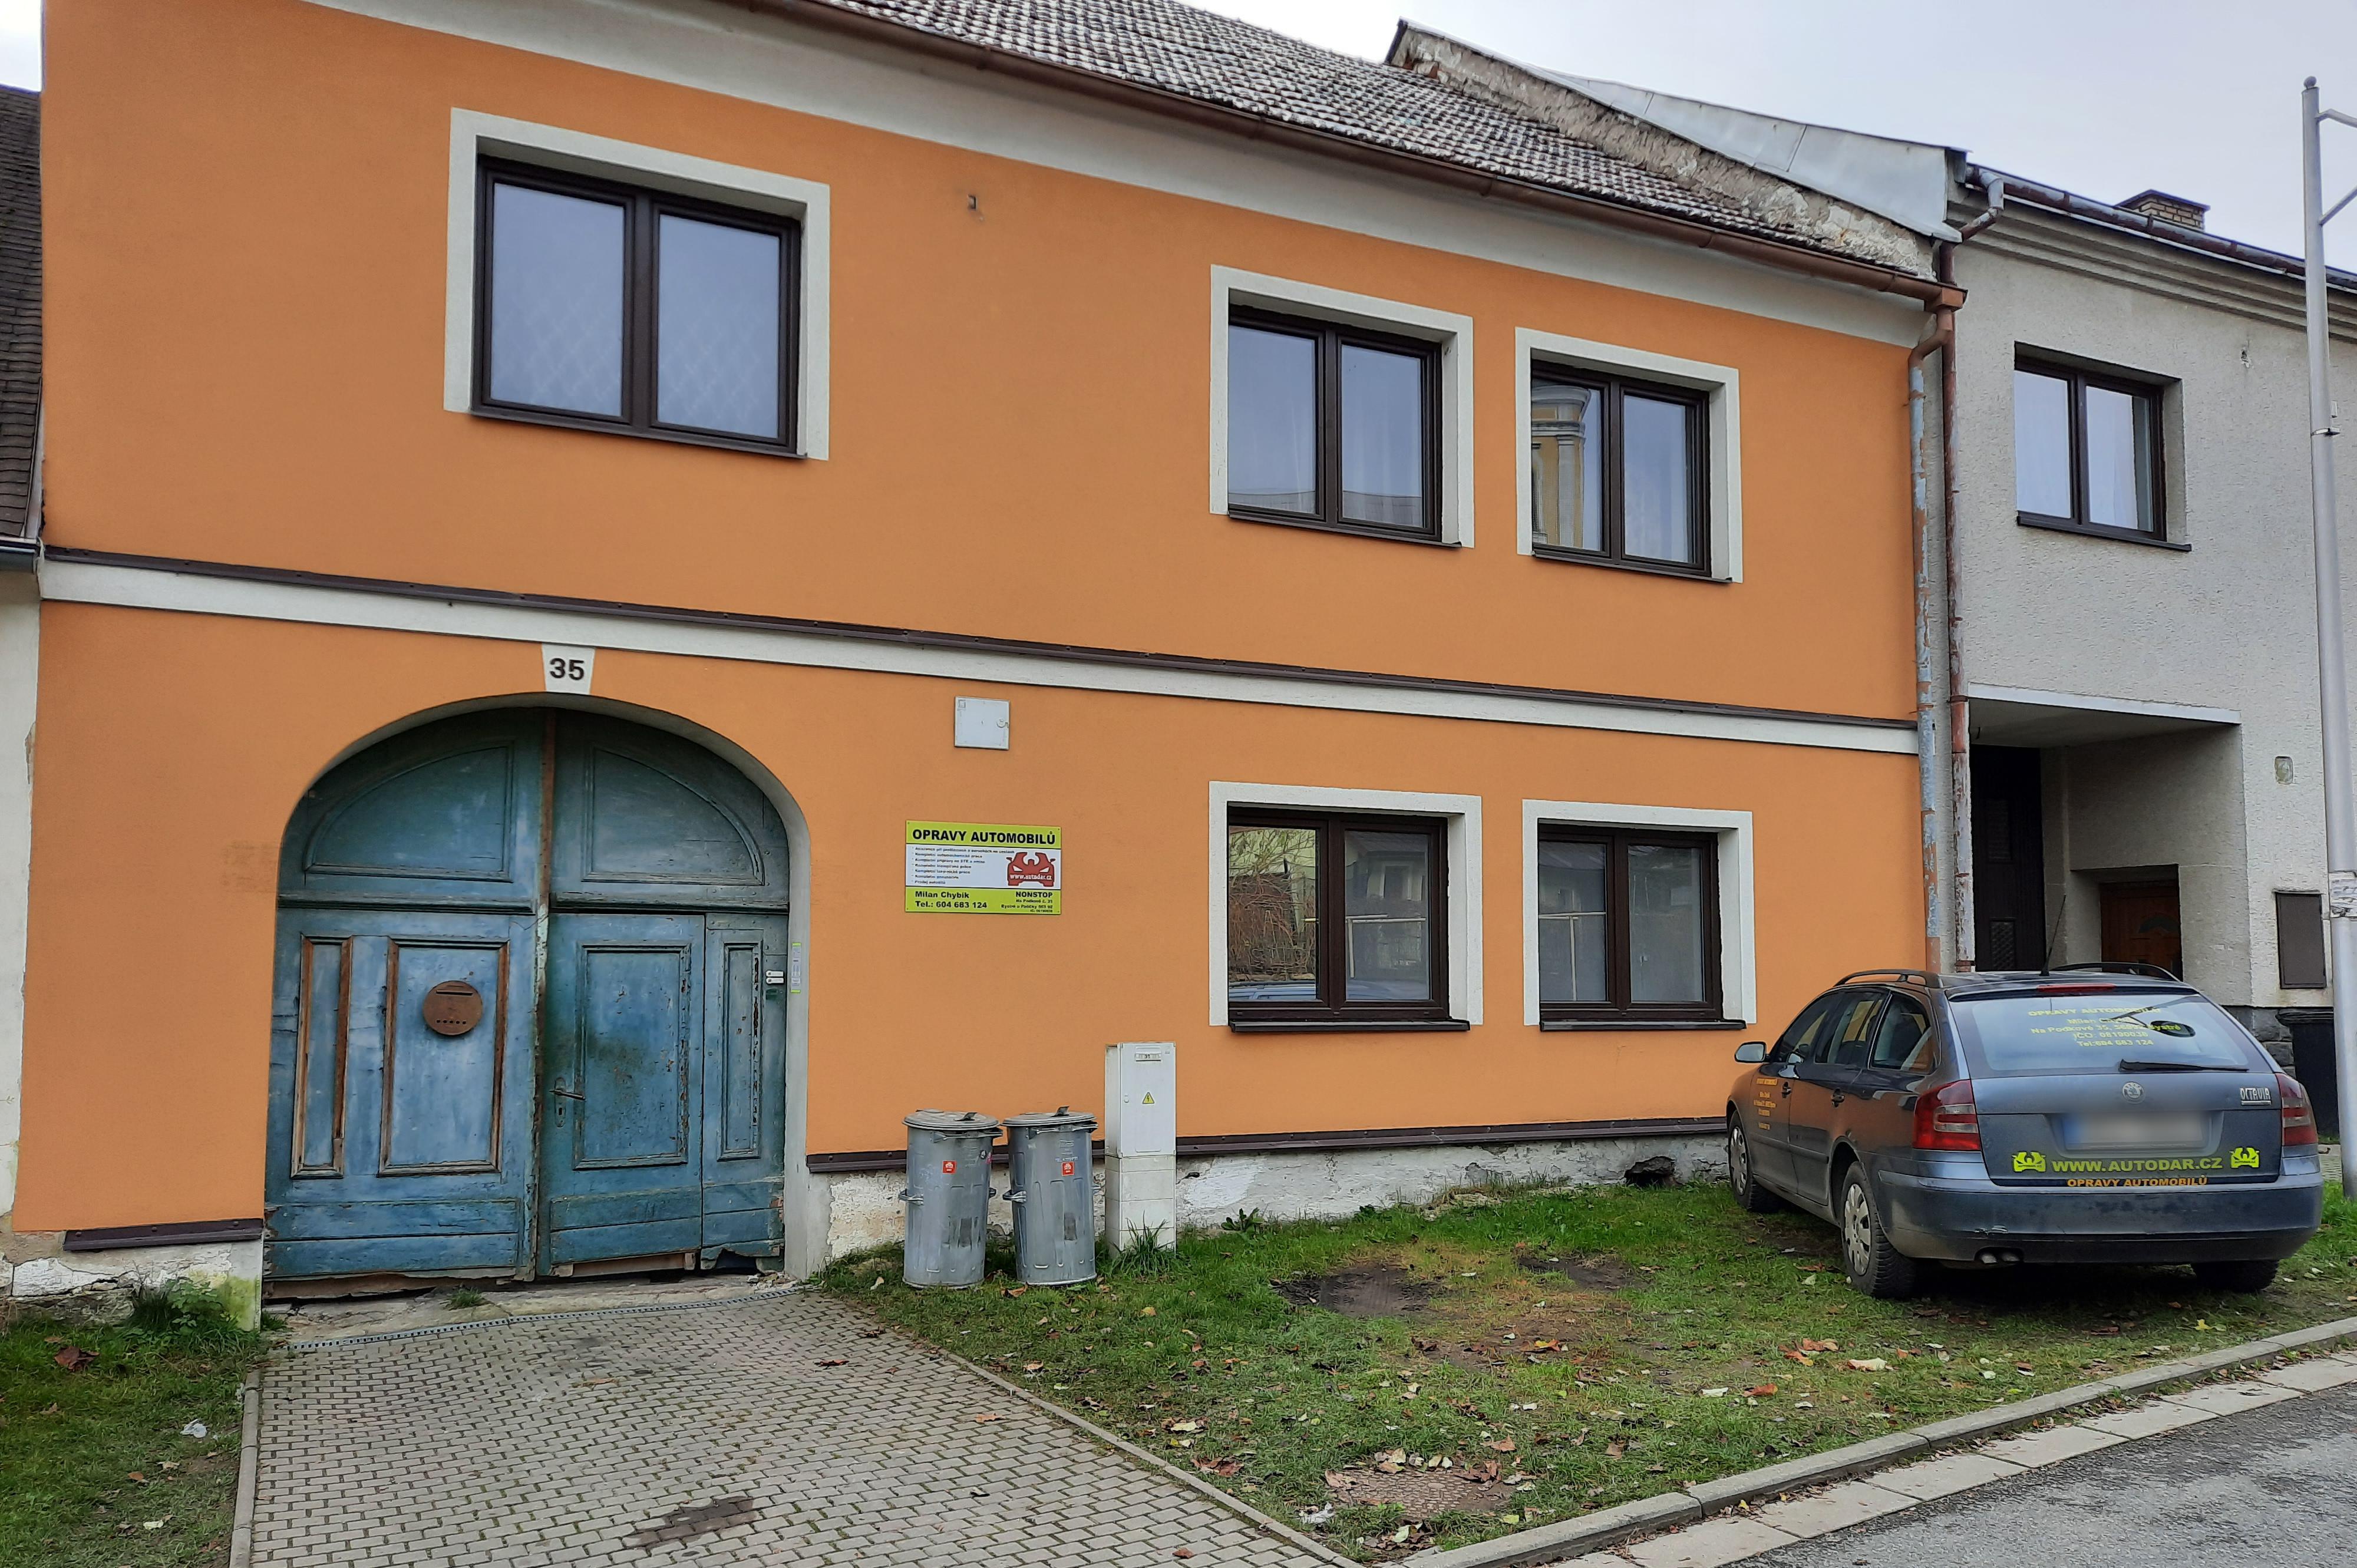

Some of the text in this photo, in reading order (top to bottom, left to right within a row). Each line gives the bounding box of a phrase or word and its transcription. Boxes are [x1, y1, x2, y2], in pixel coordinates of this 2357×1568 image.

[549, 658, 585, 681] 35
[912, 829, 1056, 844] OPRAVY AUTOMOBILŮ
[2240, 1087, 2271, 1100] OCTAVIA
[2051, 1157, 2223, 1173] WWW.AUTODAR.CZ
[2066, 1174, 2208, 1187] OPRAVY AUTOMOBILŮ
